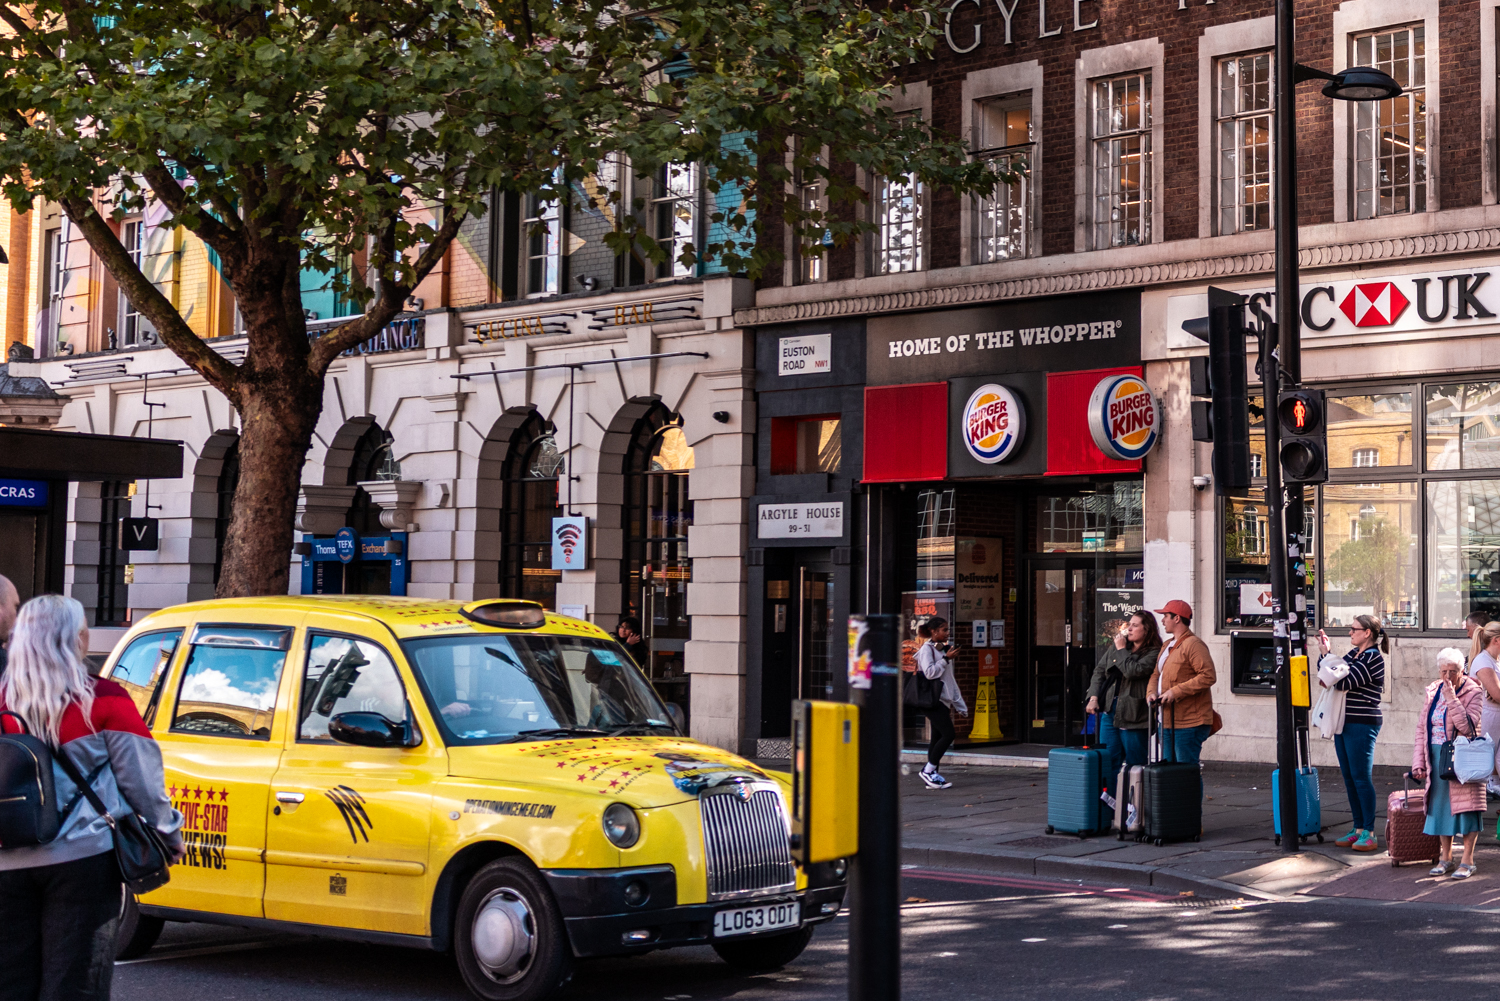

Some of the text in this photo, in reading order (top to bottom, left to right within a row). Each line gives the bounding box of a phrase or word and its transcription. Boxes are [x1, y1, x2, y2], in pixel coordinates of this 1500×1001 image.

[1412, 271, 1497, 323] UK
[614, 302, 654, 326] BAR
[476, 315, 545, 343] CUCINA
[783, 346, 815, 357] EUSTON
[889, 337, 941, 357] HOME
[945, 334, 970, 353] OF
[975, 330, 1014, 350] THE
[783, 360, 828, 370] ROAD NW1
[969, 400, 1007, 427] BURGER
[1110, 392, 1152, 419] BURGER
[970, 413, 1009, 445] KING
[1112, 407, 1154, 440] KING
[0, 486, 35, 498] CRAS
[761, 508, 840, 520] ARGYLE HOUSE
[133, 525, 147, 541] V
[337, 540, 353, 549] TEFX
[316, 543, 386, 556] Thoma Exchang
[958, 572, 999, 583] Delivered
[1102, 602, 1118, 612] The
[179, 801, 228, 833] FIVE-STAR
[177, 831, 227, 870] VIEWS!
[722, 904, 794, 932] LO63 ODT
